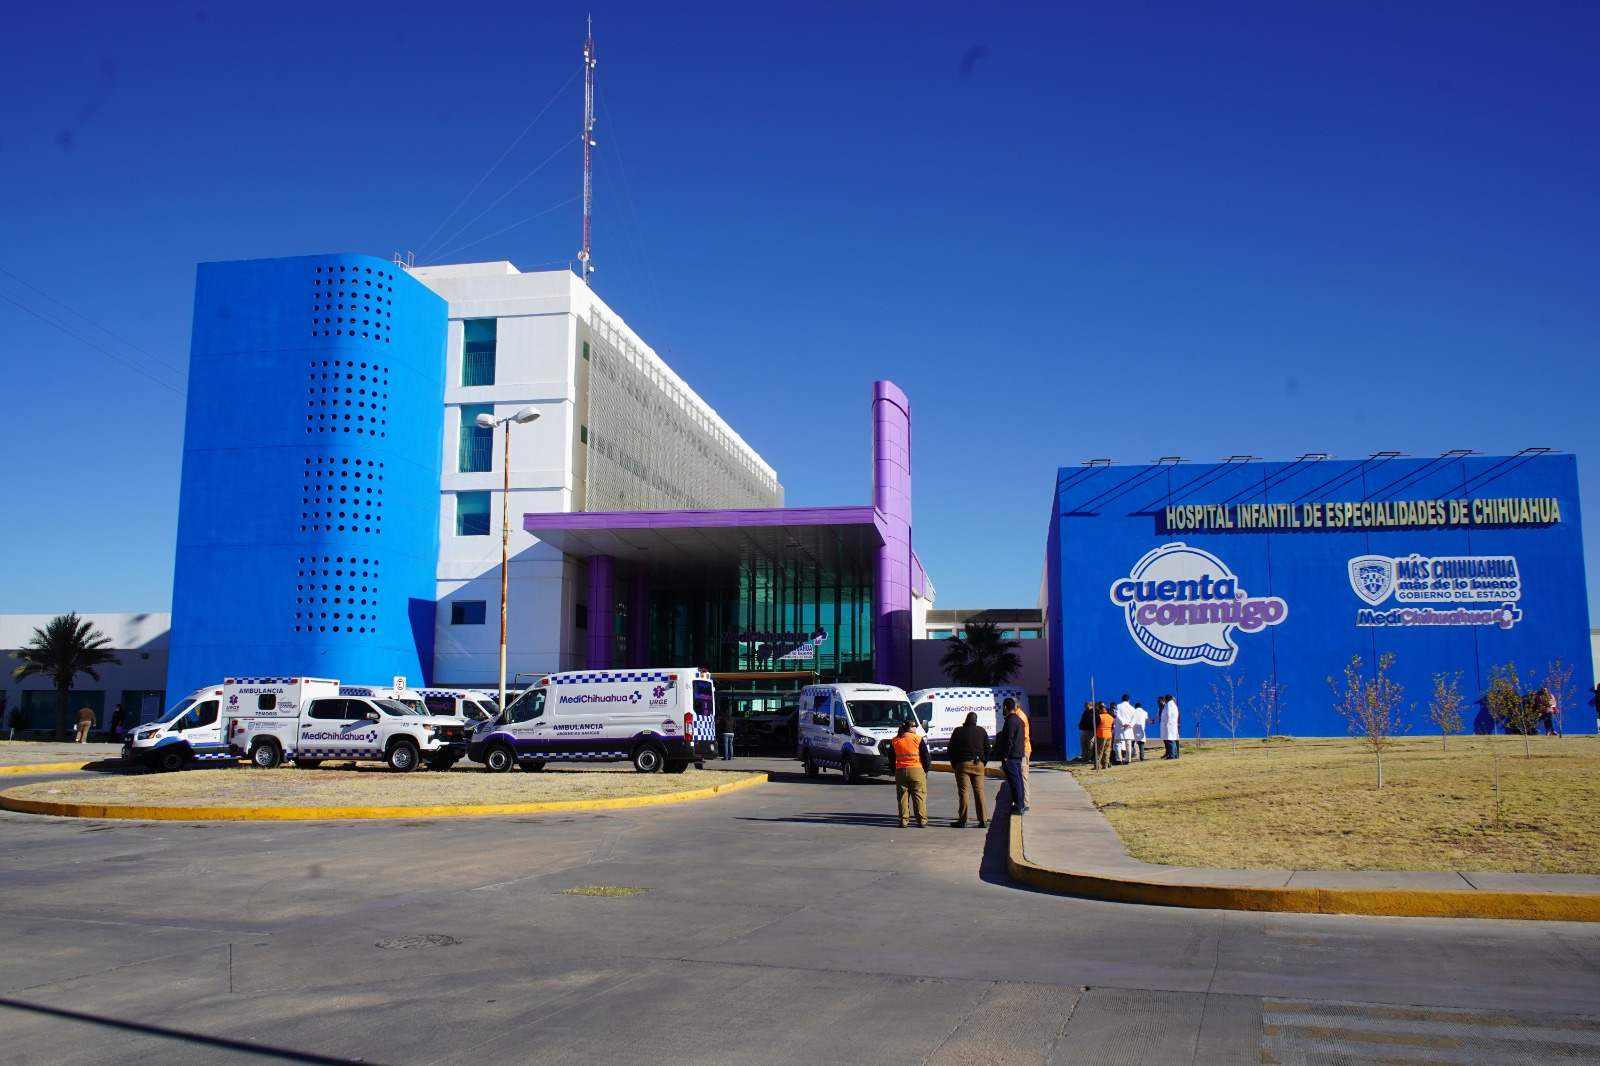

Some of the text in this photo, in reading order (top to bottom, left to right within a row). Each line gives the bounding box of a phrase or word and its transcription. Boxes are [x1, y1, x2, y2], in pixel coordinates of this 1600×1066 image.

[1165, 497, 1562, 530] HOSPITAL INFANTIL DE ESPECIALIDADES DE CHIHUAHUA
[1397, 555, 1517, 579] MÁS CHIHUAHUA
[1114, 574, 1236, 602] cuenta
[1398, 578, 1518, 590] más de lo bueno
[1399, 590, 1517, 600] GOBIERNO DEL ESTADO
[1136, 597, 1284, 630] conmigo
[1357, 608, 1494, 625] MediChihuahua
[721, 631, 809, 643] MediChihuahua
[559, 693, 628, 704] MediChihuahua
[945, 705, 993, 713] MediChihuahua
[301, 731, 365, 741] MediChihuahua
